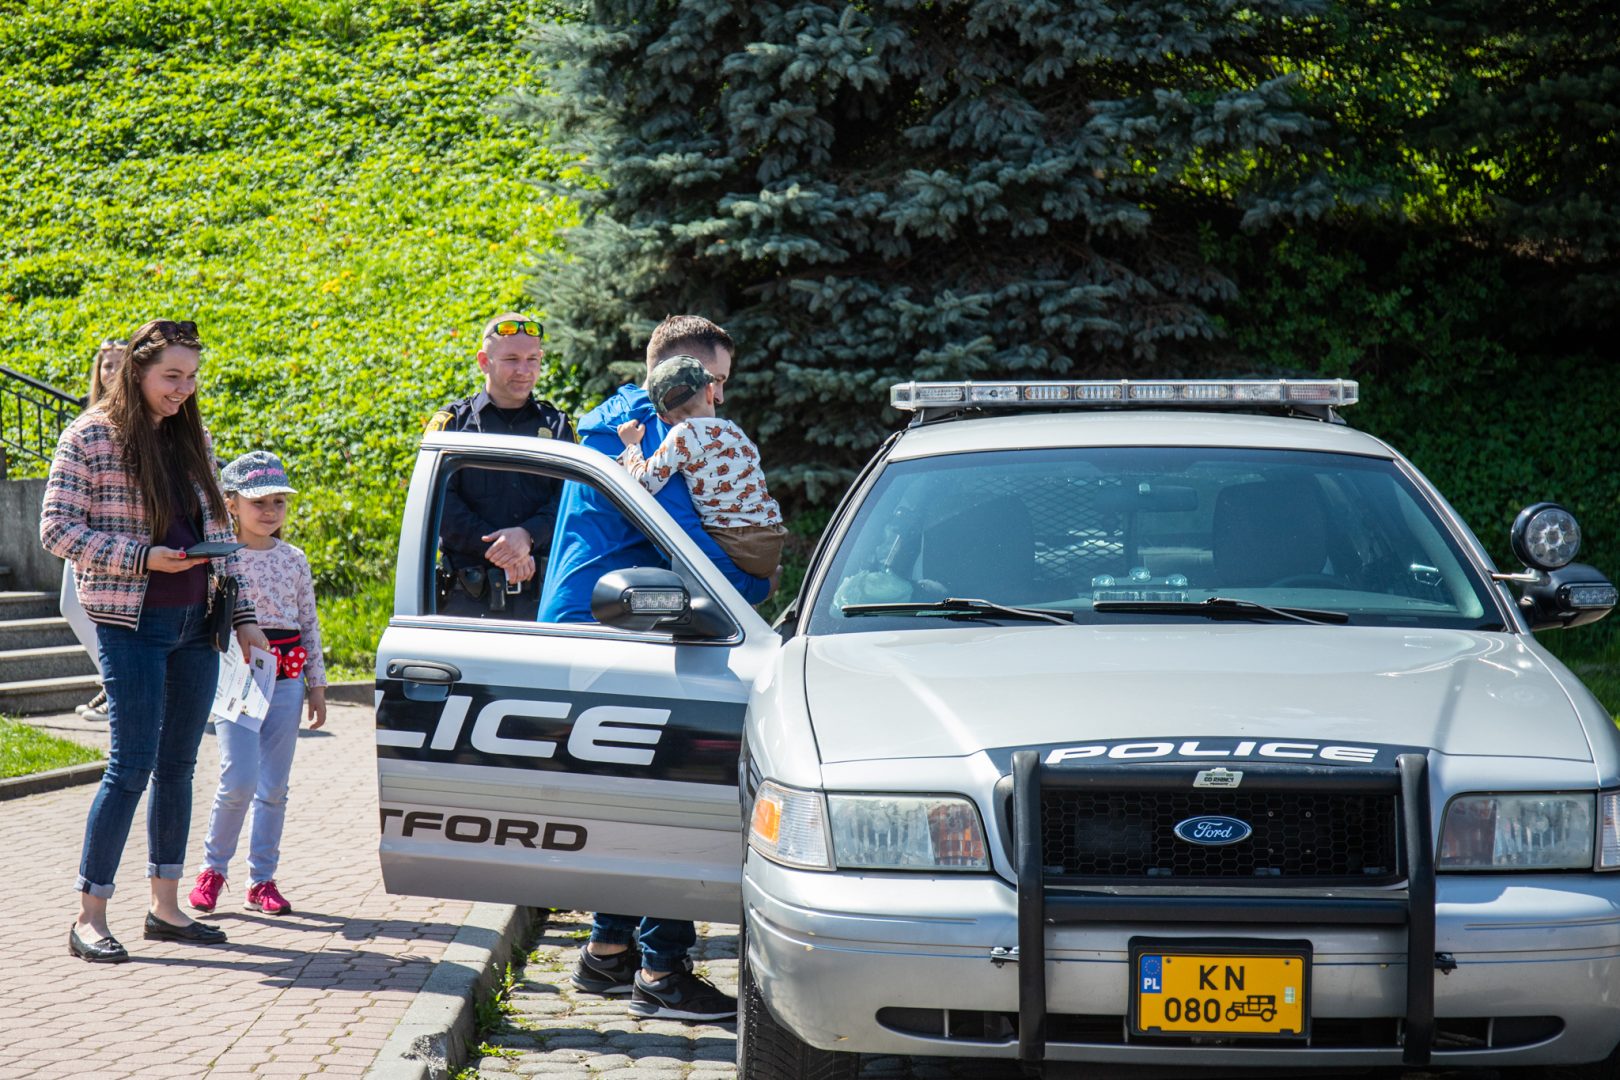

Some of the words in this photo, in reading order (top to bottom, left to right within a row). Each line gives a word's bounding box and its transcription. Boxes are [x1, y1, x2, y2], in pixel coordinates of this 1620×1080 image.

[1044, 740, 1379, 765] POLICE
[1193, 821, 1233, 839] Ford
[1143, 977, 1160, 990] PL
[1199, 964, 1245, 991] KN
[1164, 997, 1221, 1023] 080
